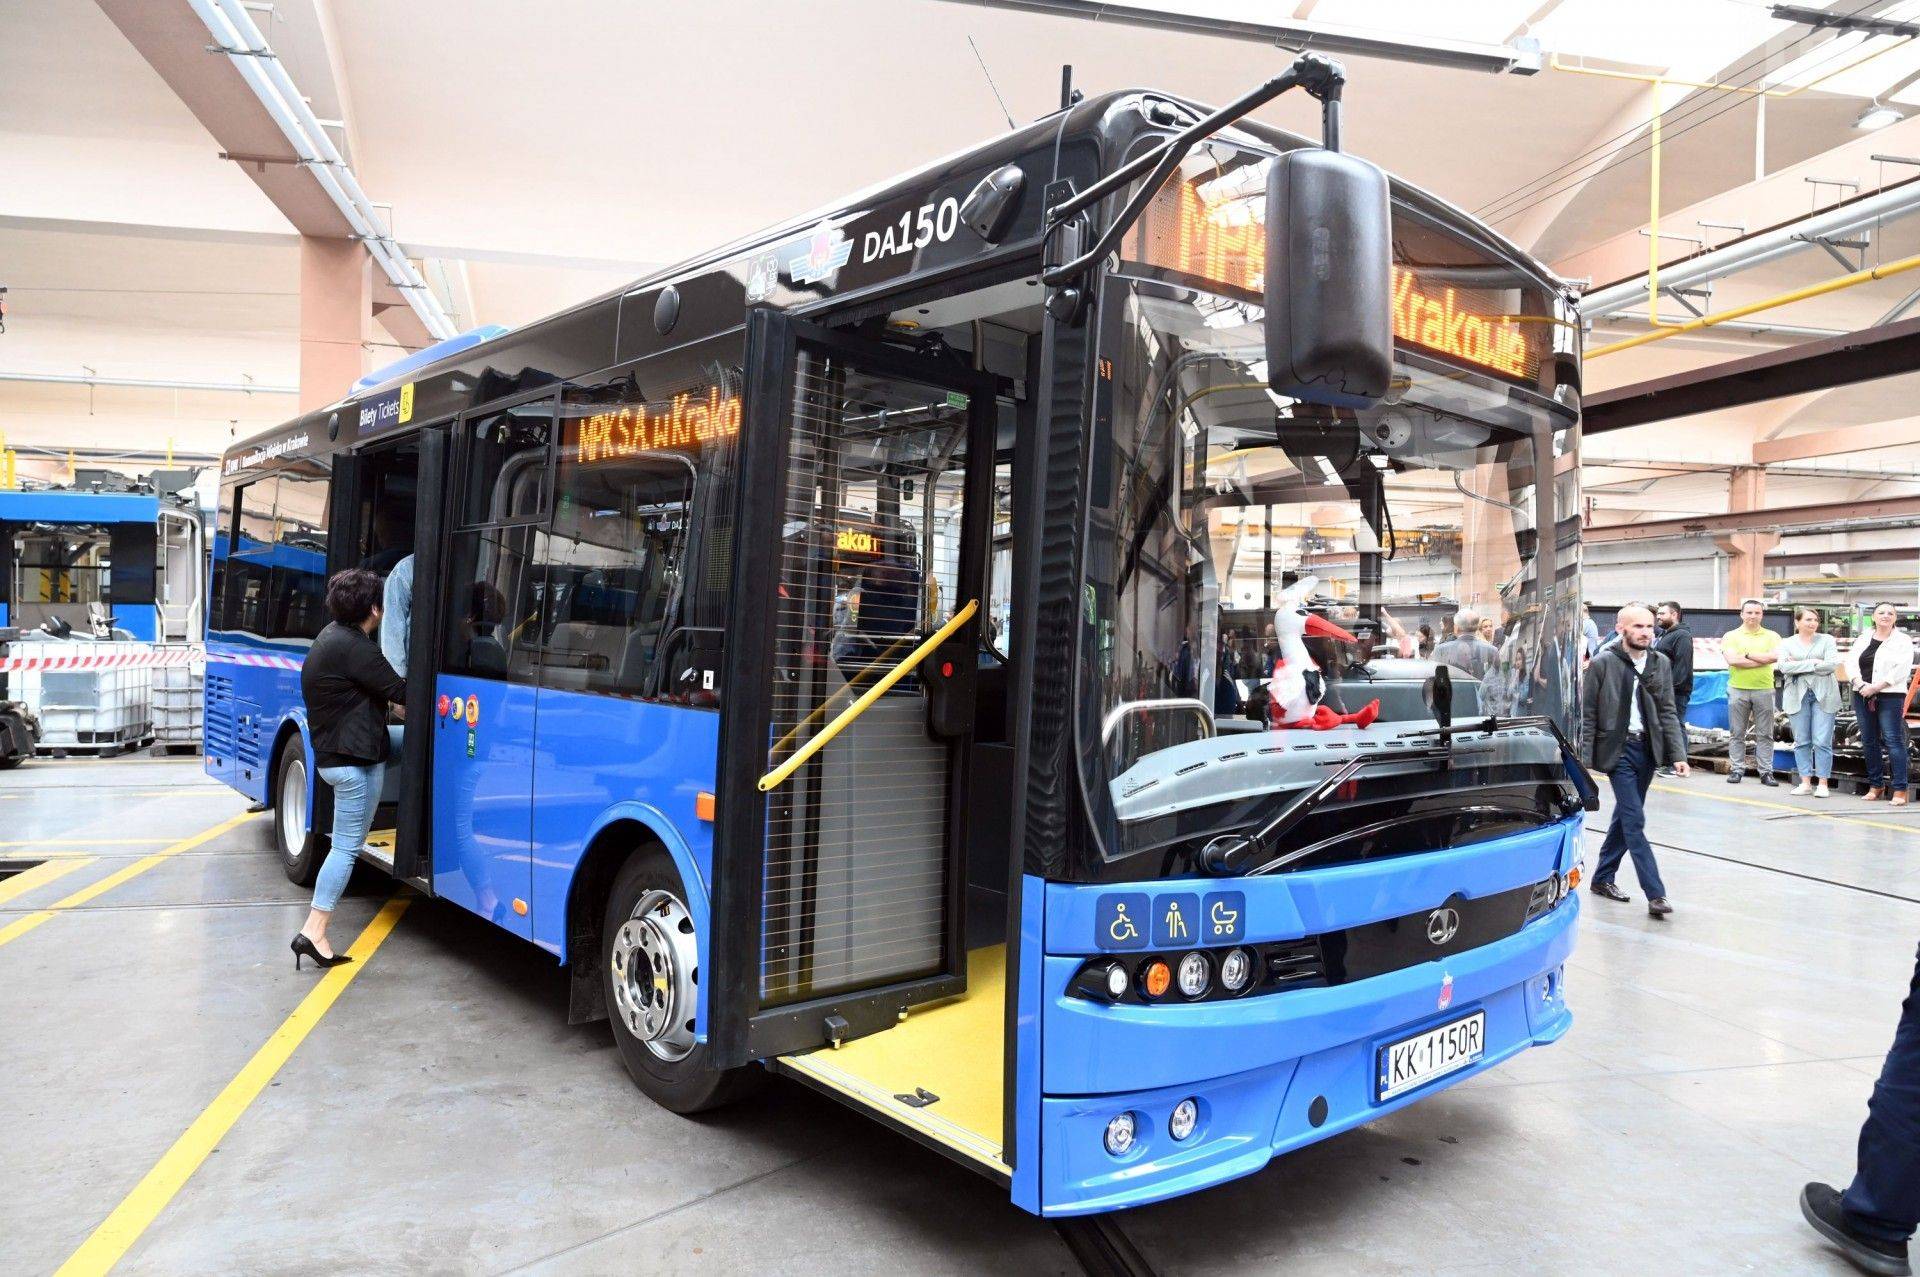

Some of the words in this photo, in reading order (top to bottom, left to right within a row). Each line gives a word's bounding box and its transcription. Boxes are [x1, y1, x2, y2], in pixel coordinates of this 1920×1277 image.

[863, 197, 959, 264] DA150
[1391, 265, 1526, 377] Krakowie
[360, 408, 378, 427] Bilety
[378, 400, 400, 420] Tickets
[578, 411, 617, 463] MPK
[653, 413, 670, 448] w
[1380, 1074, 1388, 1086] PL
[1393, 1042, 1417, 1083] KK
[1427, 1019, 1479, 1068] 1150R
